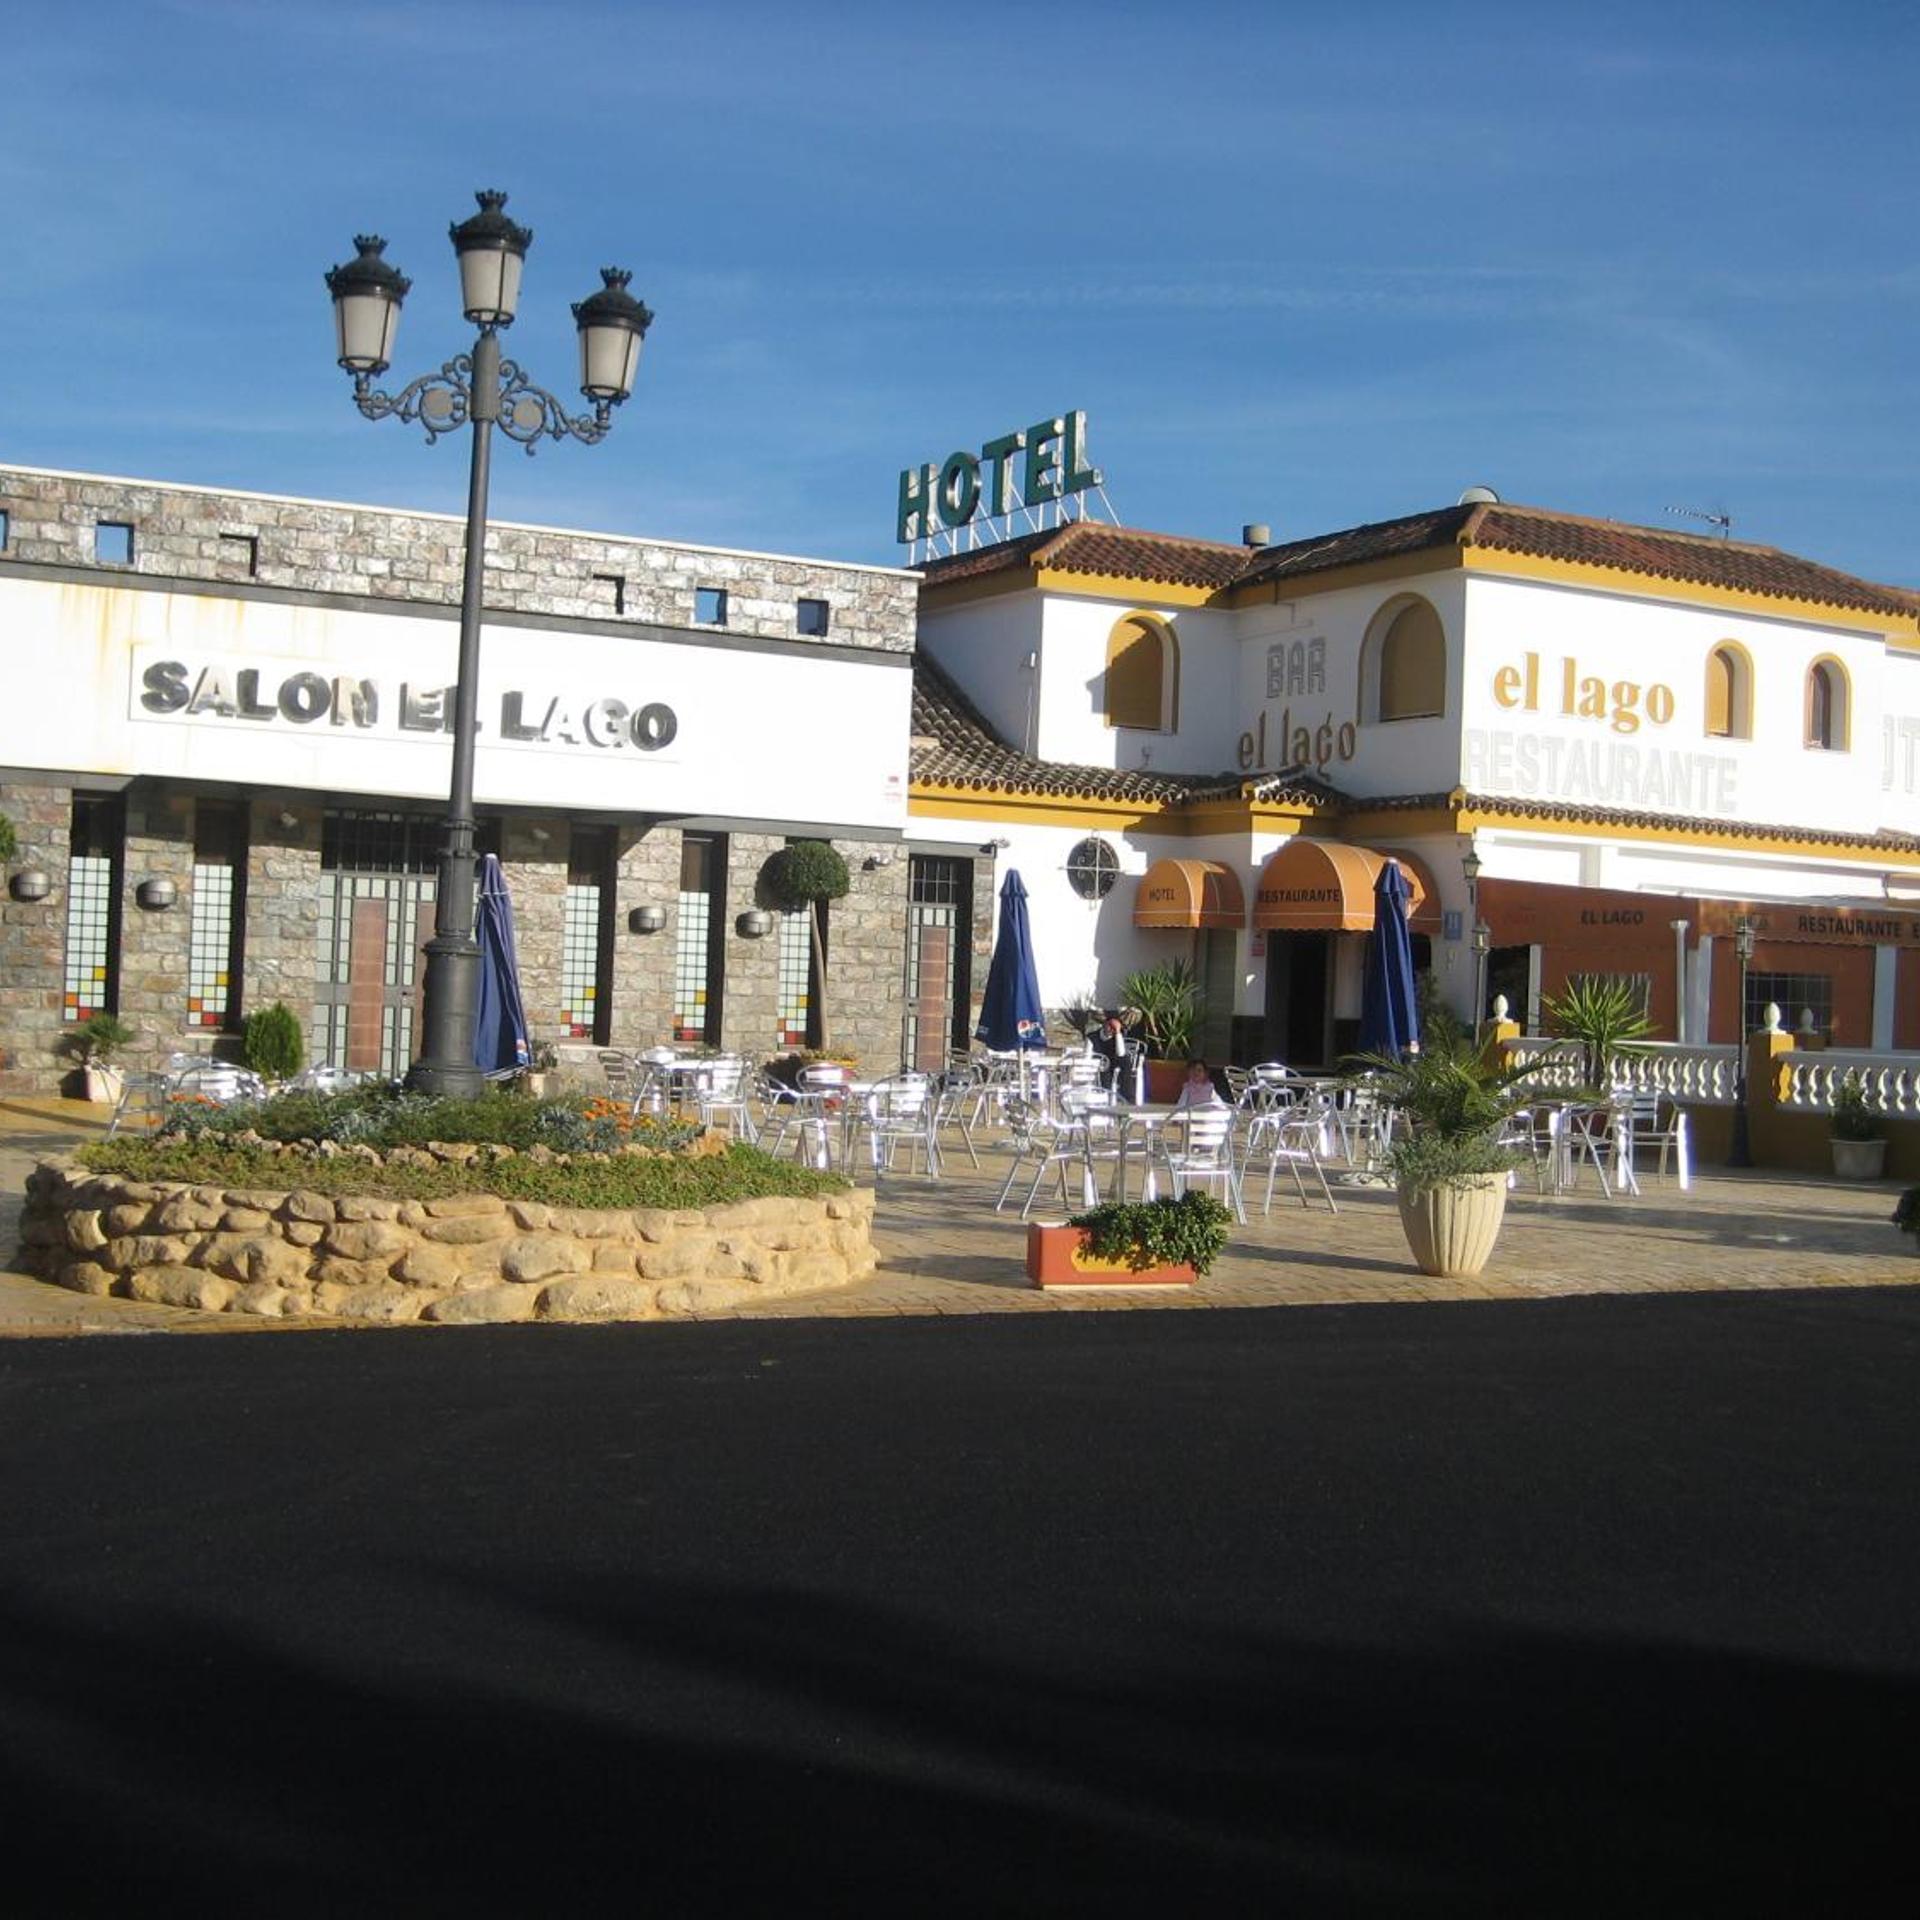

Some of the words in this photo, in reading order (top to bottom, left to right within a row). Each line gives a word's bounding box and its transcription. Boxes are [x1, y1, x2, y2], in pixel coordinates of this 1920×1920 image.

[897, 409, 1102, 543] HOTEL
[1265, 636, 1327, 699] BAR
[1494, 651, 1540, 711] el
[1560, 656, 1675, 734] lago
[140, 660, 379, 728] SALON
[500, 690, 678, 752] LAGO
[1238, 710, 1266, 770] el
[1463, 728, 1737, 813] RESTAURANTE
[1148, 887, 1176, 902] HOTEL
[1580, 908, 1597, 925] EL
[1601, 908, 1644, 926] LAGO
[1798, 915, 1901, 939] RESTAURANTE
